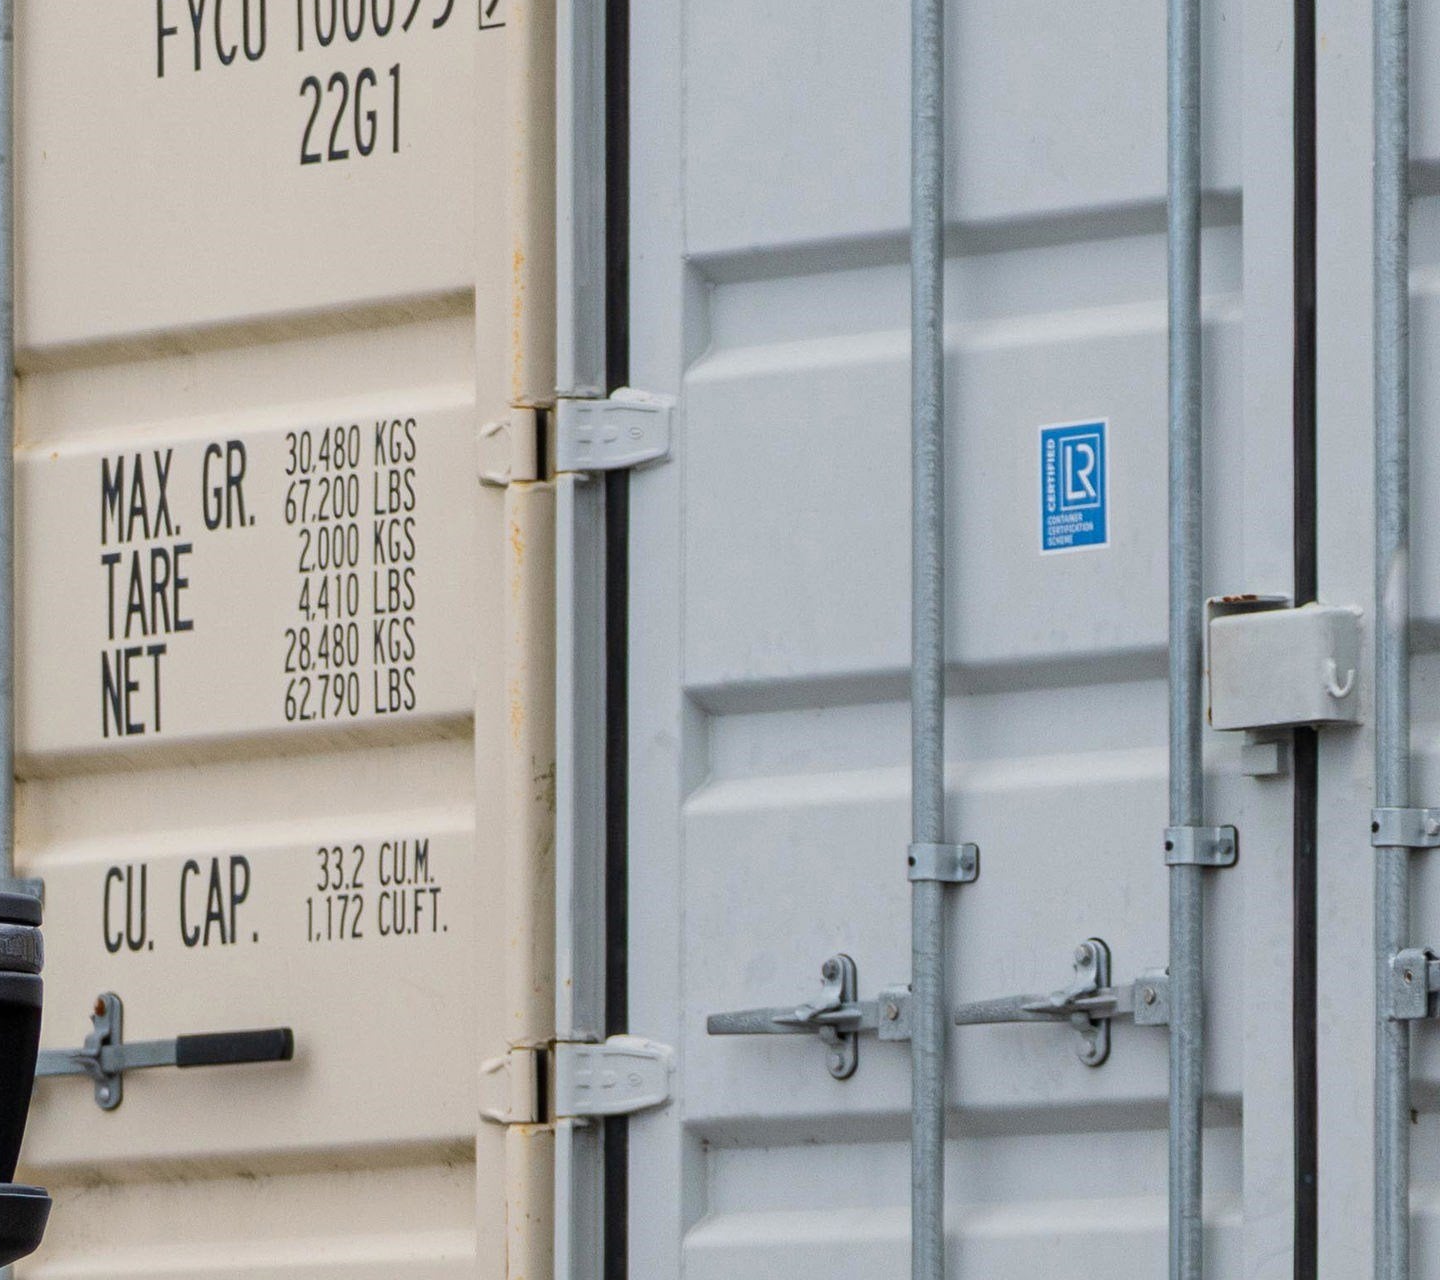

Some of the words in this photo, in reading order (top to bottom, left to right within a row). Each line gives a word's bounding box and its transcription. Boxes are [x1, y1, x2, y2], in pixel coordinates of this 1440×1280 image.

[300, 64, 399, 165] 22G1
[102, 449, 180, 545] MAX.
[203, 440, 254, 530] GR.
[286, 425, 359, 475] 30,480
[375, 419, 415, 465] KGS
[285, 474, 359, 524] 67,200
[375, 468, 415, 515] LBS
[102, 544, 193, 640] TARE
[299, 523, 358, 573] 2,000
[375, 517, 415, 564] KGS
[299, 573, 358, 620] 4,410
[374, 568, 415, 614] LBS
[102, 644, 166, 738] NET
[285, 622, 358, 673] 28,480
[374, 617, 415, 664] KGS
[375, 667, 415, 713] LBS
[104, 864, 153, 953] CU.
[180, 856, 258, 947] CAP.
[318, 845, 364, 891] 33.2
[380, 839, 434, 886] CU.M.
[379, 888, 447, 936] CU.FT.
